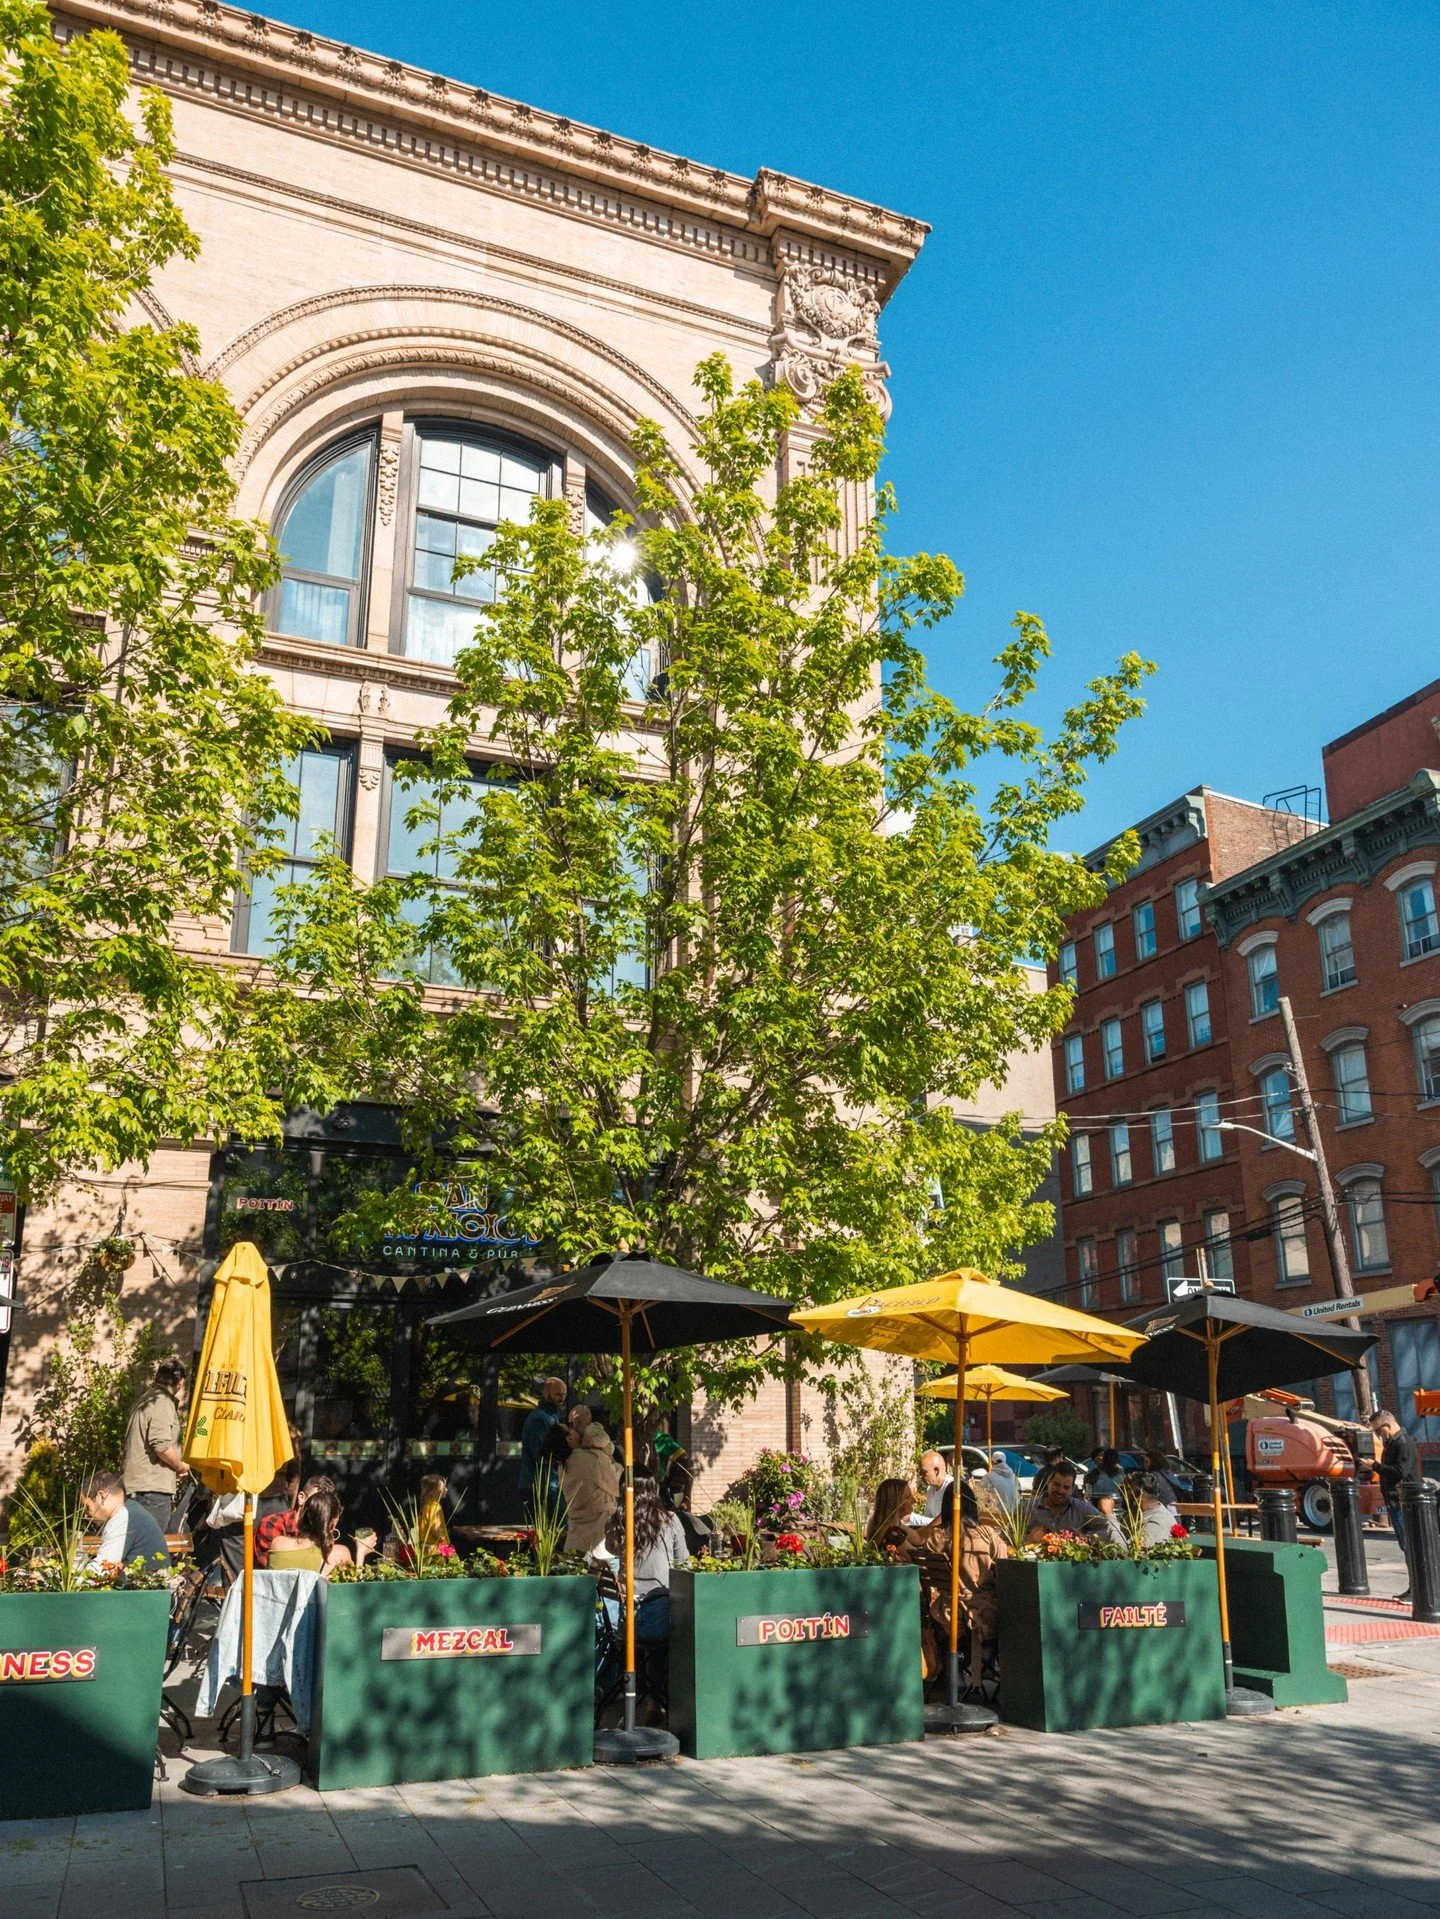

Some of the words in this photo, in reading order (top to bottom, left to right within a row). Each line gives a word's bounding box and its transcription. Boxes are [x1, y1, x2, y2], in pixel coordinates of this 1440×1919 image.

[382, 1245, 460, 1259] CANTINA
[468, 1249, 478, 1259] &
[1313, 1304, 1335, 1315] United
[1336, 1299, 1361, 1310] Rentals
[759, 1612, 849, 1644] POITÍN
[1100, 1602, 1167, 1628] FAILTÉ
[411, 1628, 513, 1656] MEZCAL
